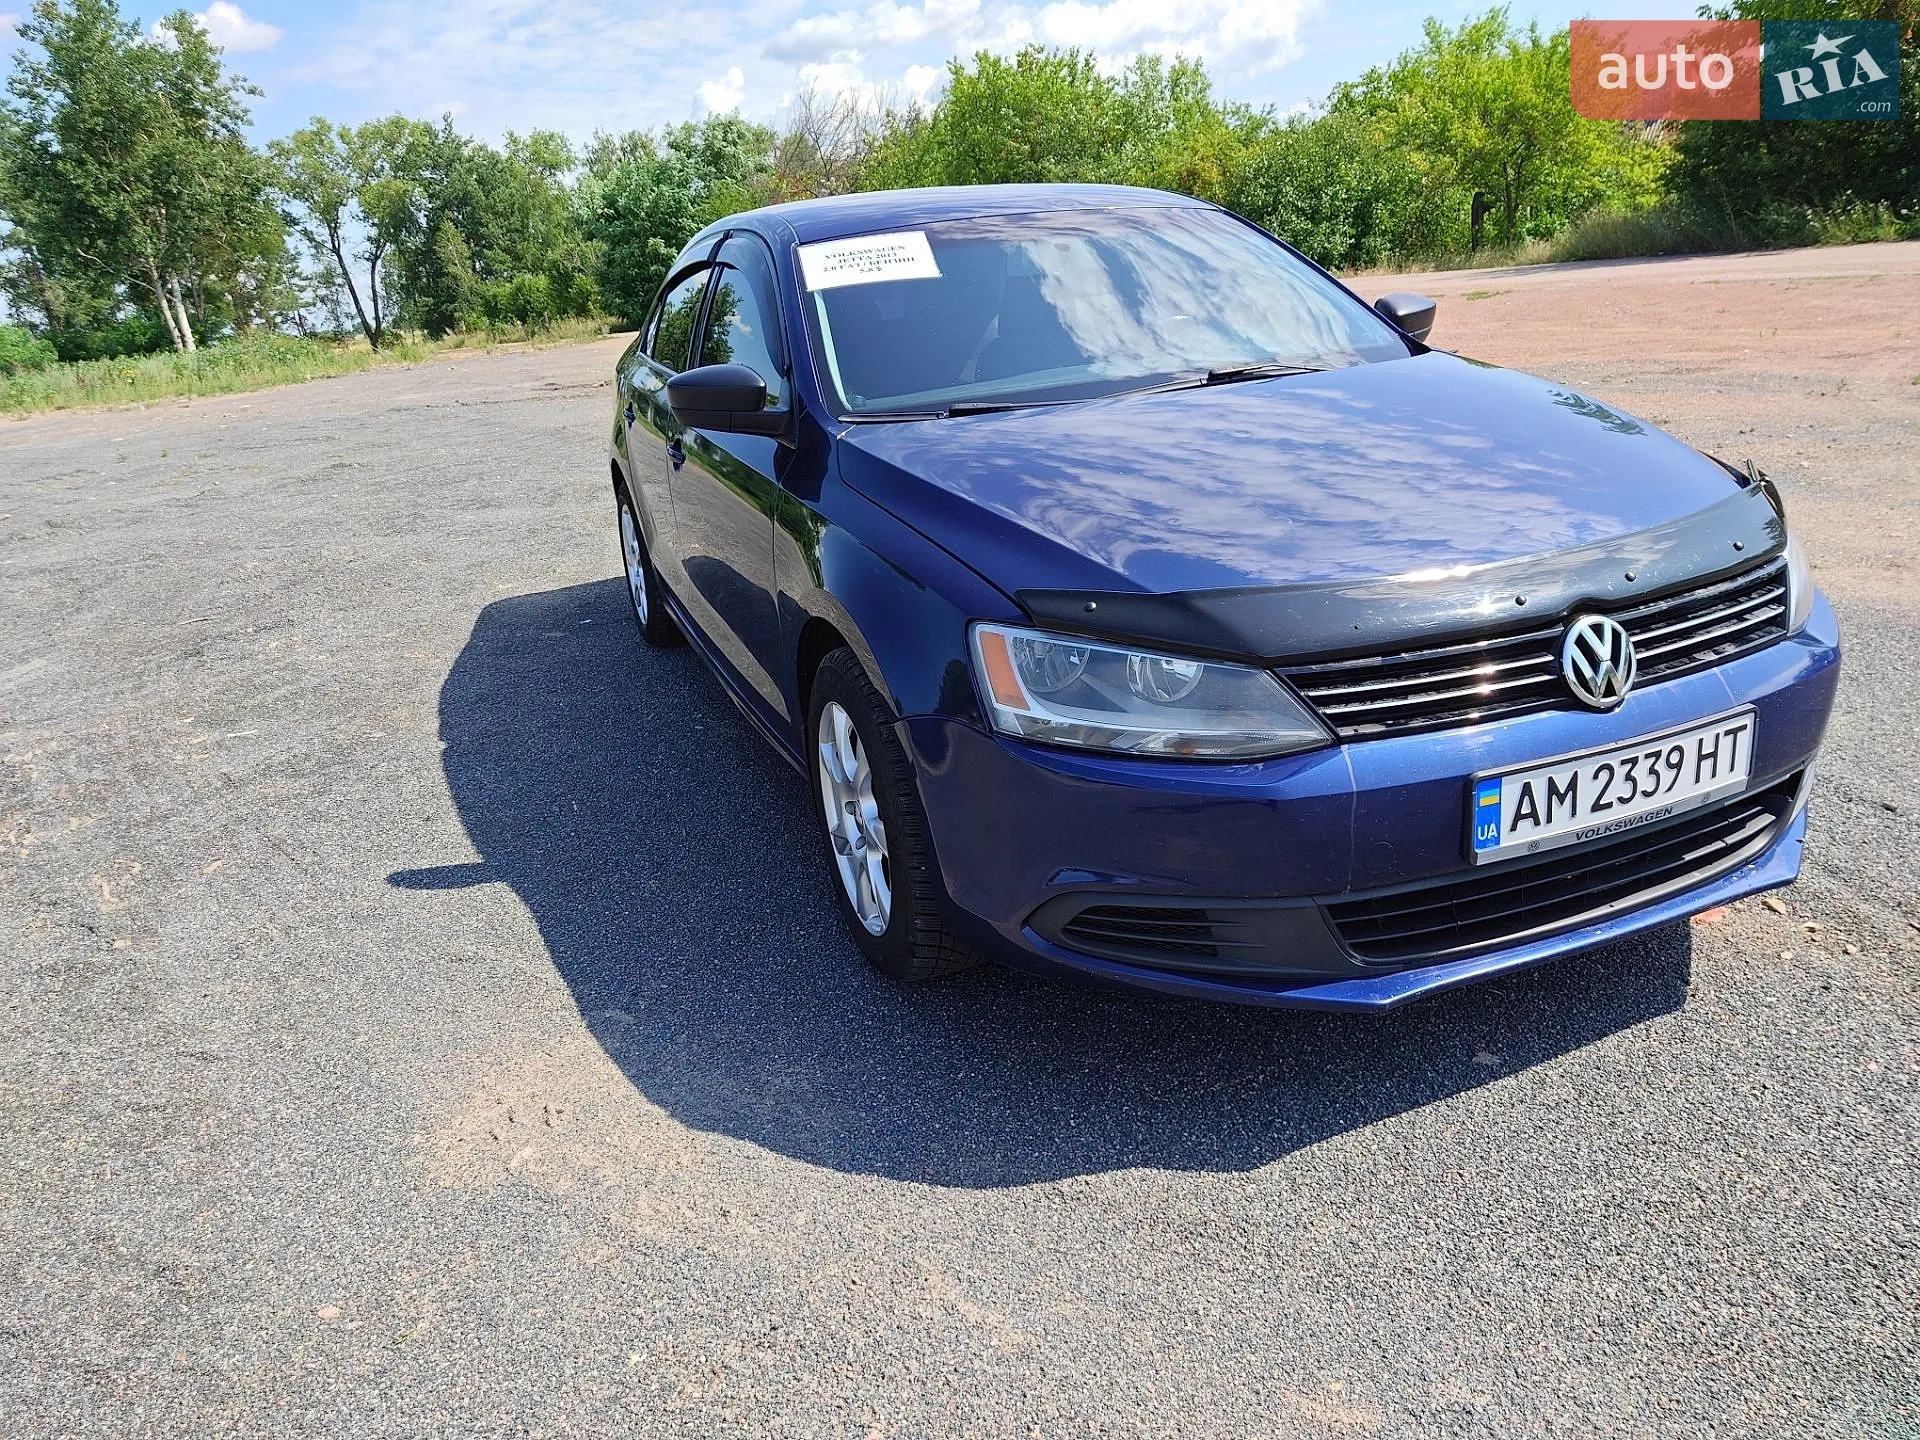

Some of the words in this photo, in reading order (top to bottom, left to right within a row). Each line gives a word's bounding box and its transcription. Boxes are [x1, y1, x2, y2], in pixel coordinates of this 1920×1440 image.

[824, 245, 906, 260] VOLKSWAGEN
[838, 254, 873, 264] JETTA
[1509, 770, 1579, 832] AM
[1590, 744, 1684, 813] 2339
[1694, 724, 1748, 784] HT
[1477, 822, 1498, 840] UA
[1575, 806, 1673, 841] VOLKSWAGEN
